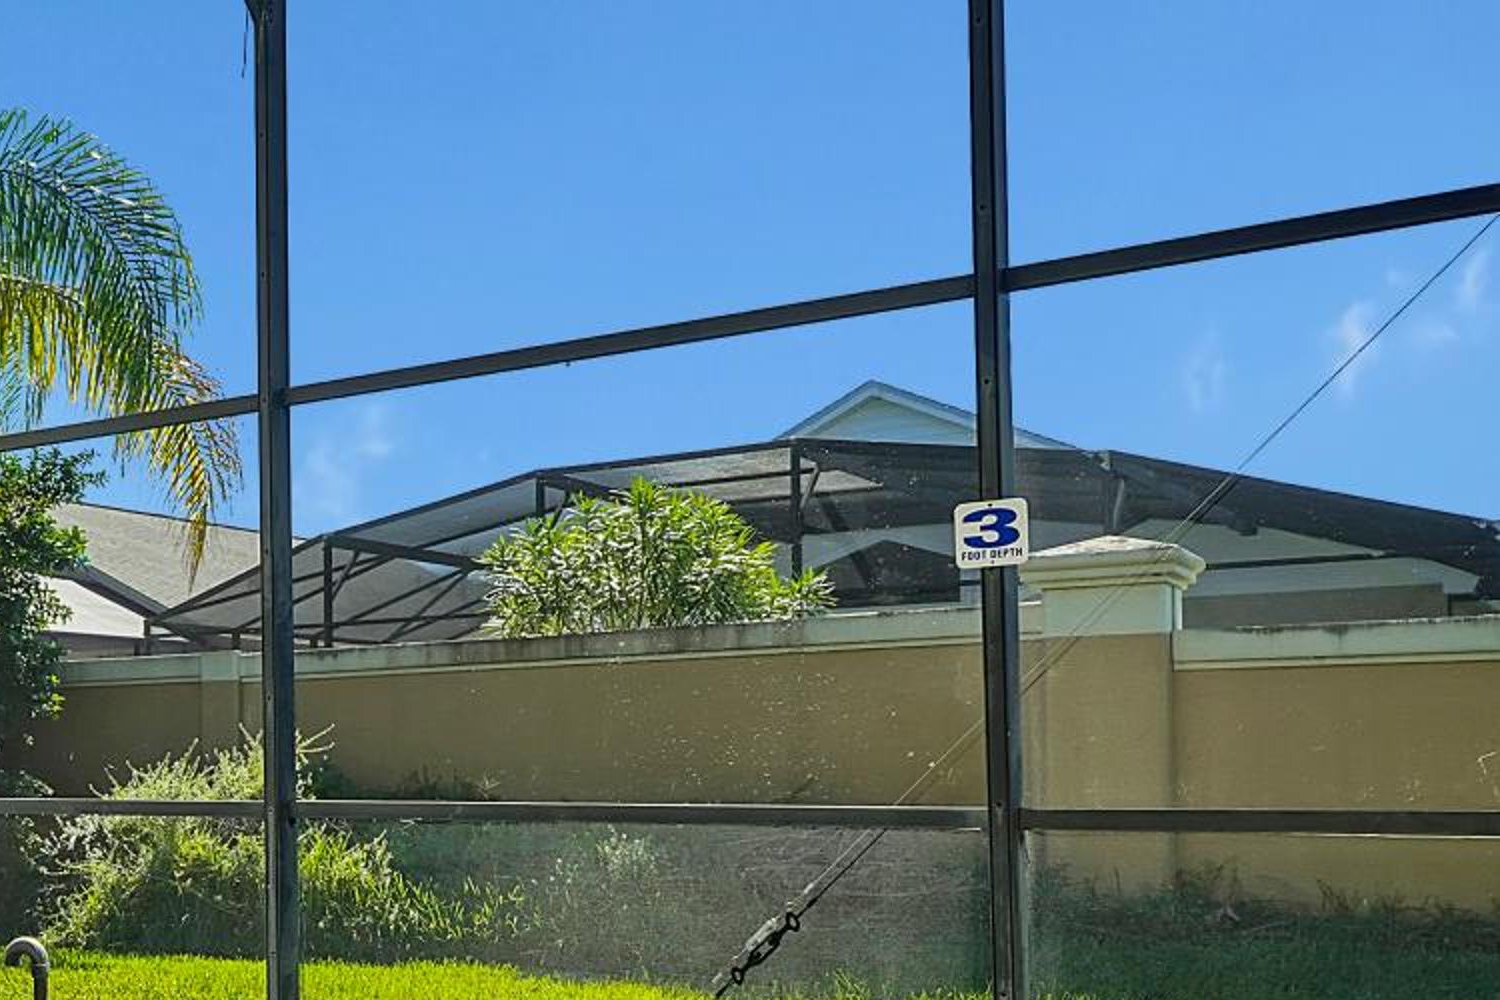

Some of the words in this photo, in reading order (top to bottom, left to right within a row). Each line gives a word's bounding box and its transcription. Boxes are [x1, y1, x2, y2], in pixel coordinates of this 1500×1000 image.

[963, 508, 1020, 549] 3
[961, 550, 987, 561] FOOT
[989, 547, 1023, 559] DEPTH
